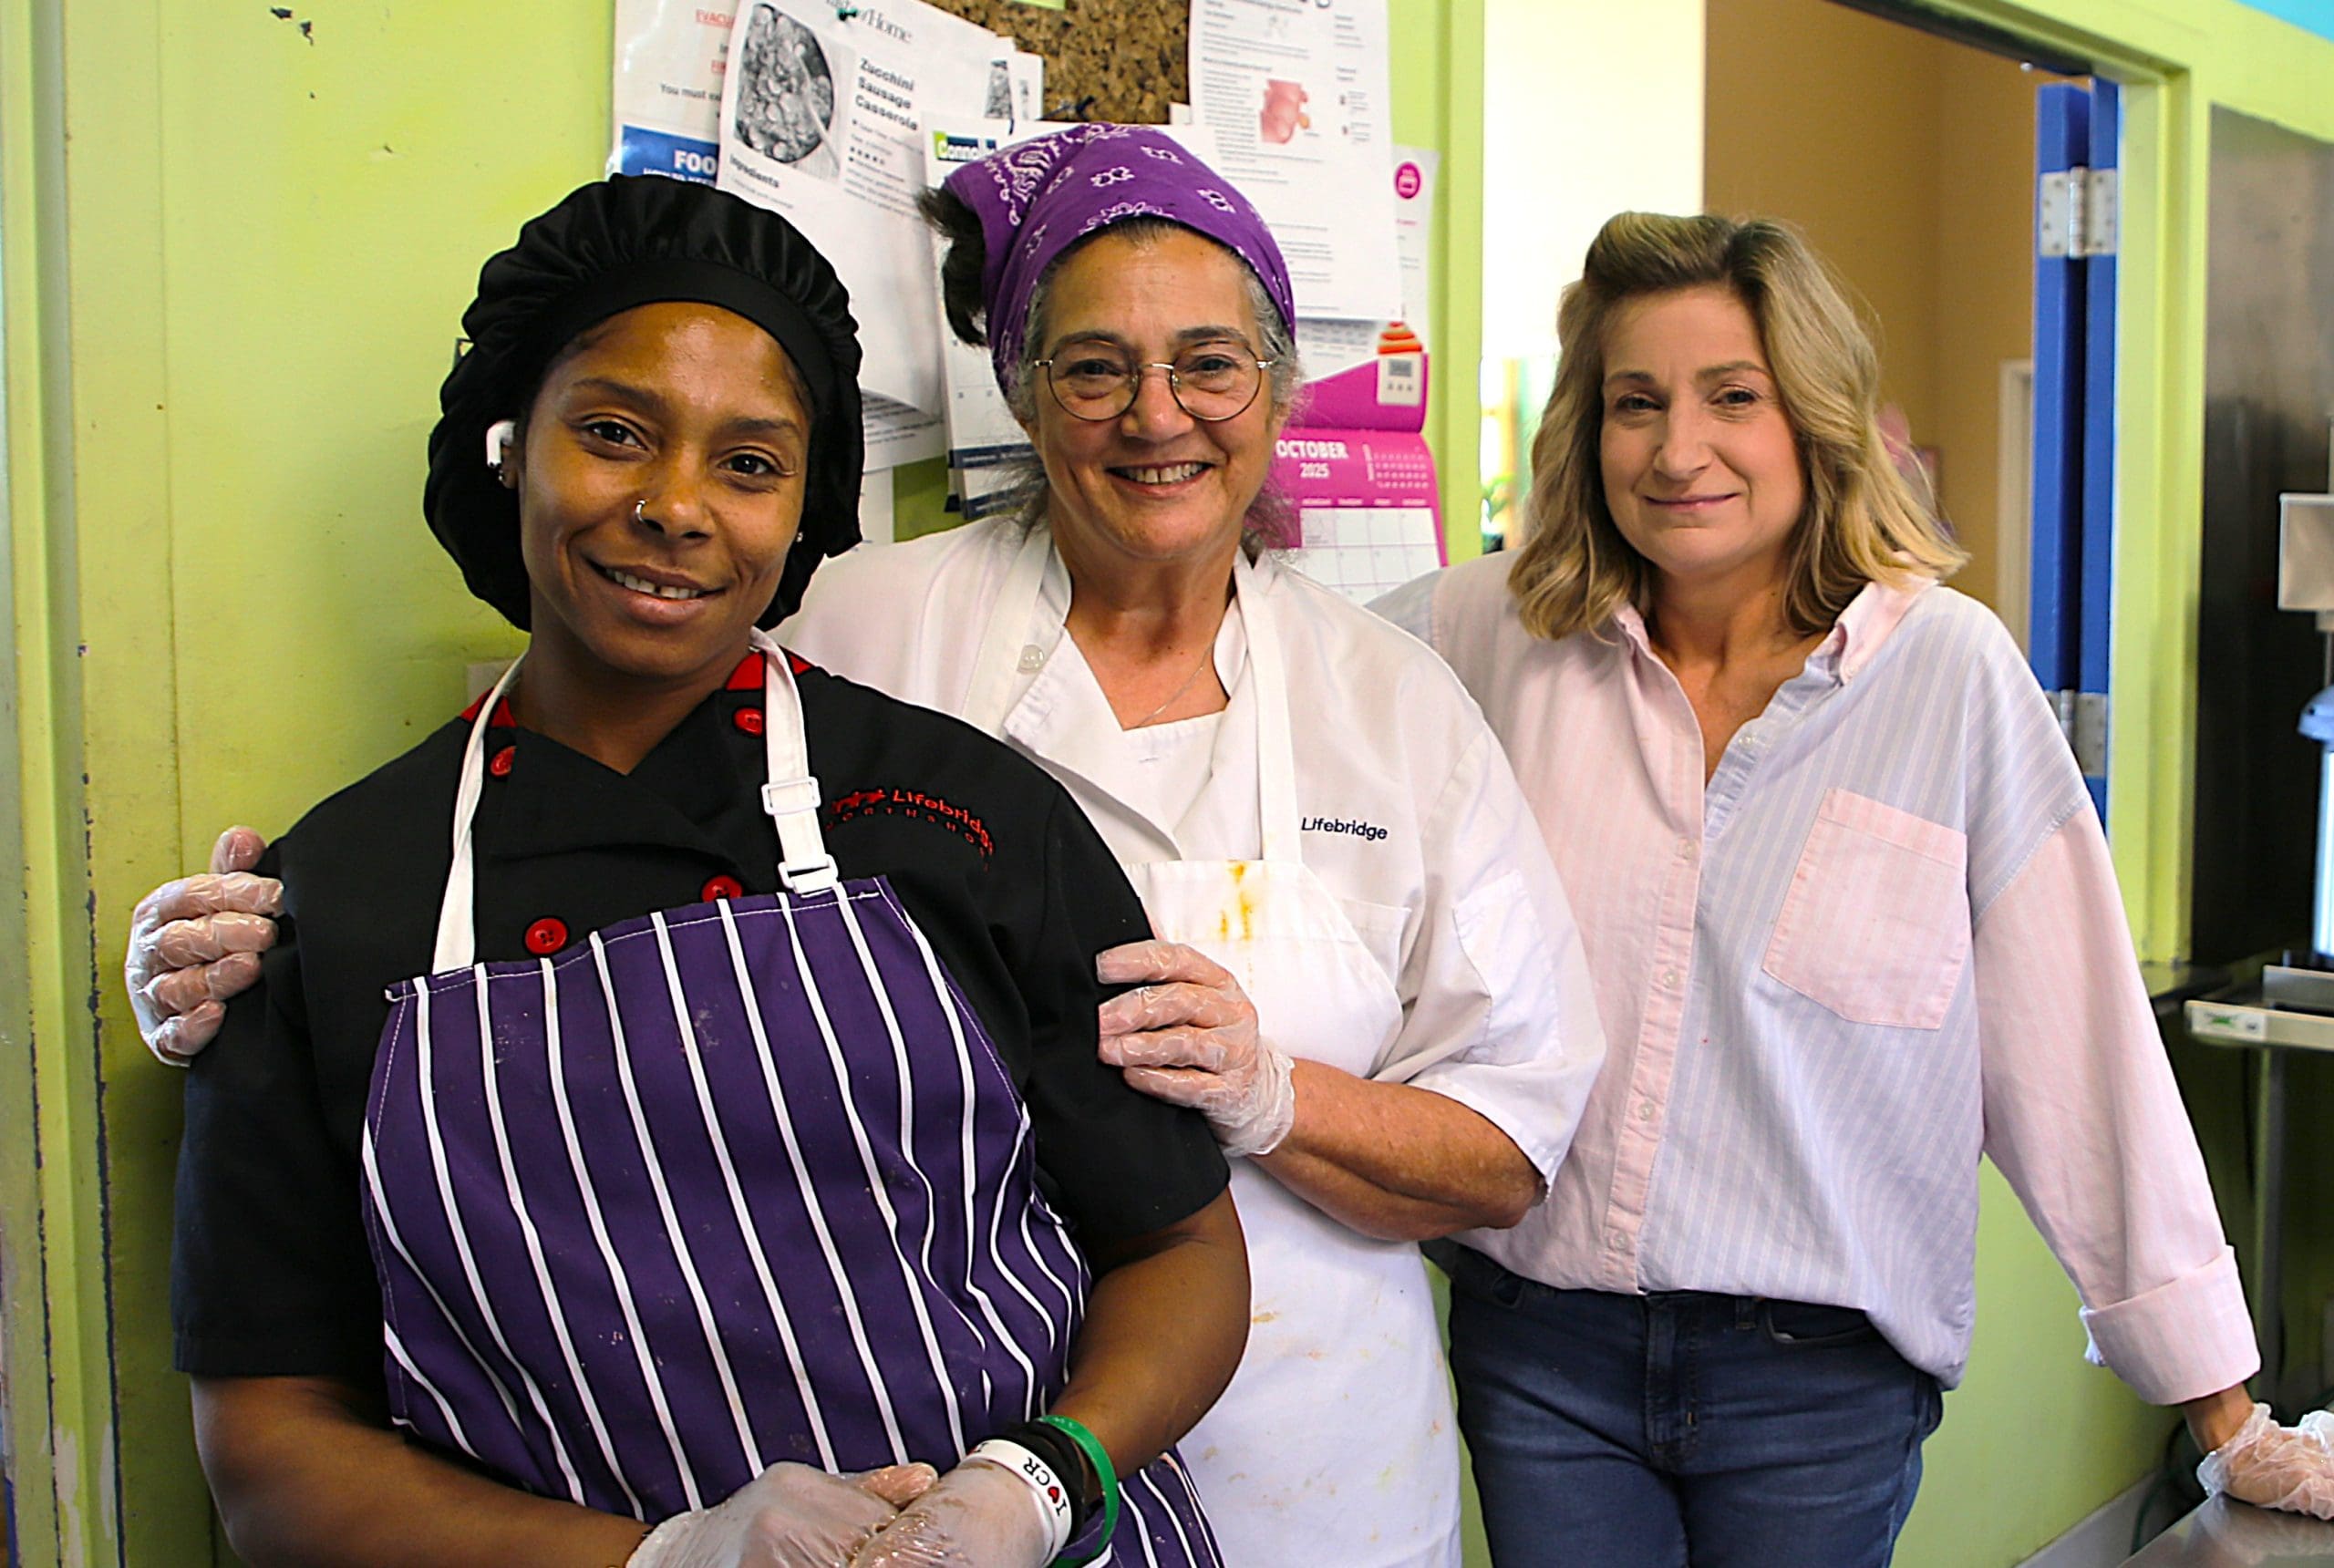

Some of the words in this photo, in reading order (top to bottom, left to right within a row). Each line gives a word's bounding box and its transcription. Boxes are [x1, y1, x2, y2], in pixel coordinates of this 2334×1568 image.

[860, 57, 914, 91] Zucchini
[858, 76, 911, 109] Sausage
[855, 94, 917, 130] Casserole
[1275, 439, 1348, 459] OCTOBER
[1299, 462, 1329, 479] 2025
[1301, 817, 1388, 841] Lifebridge
